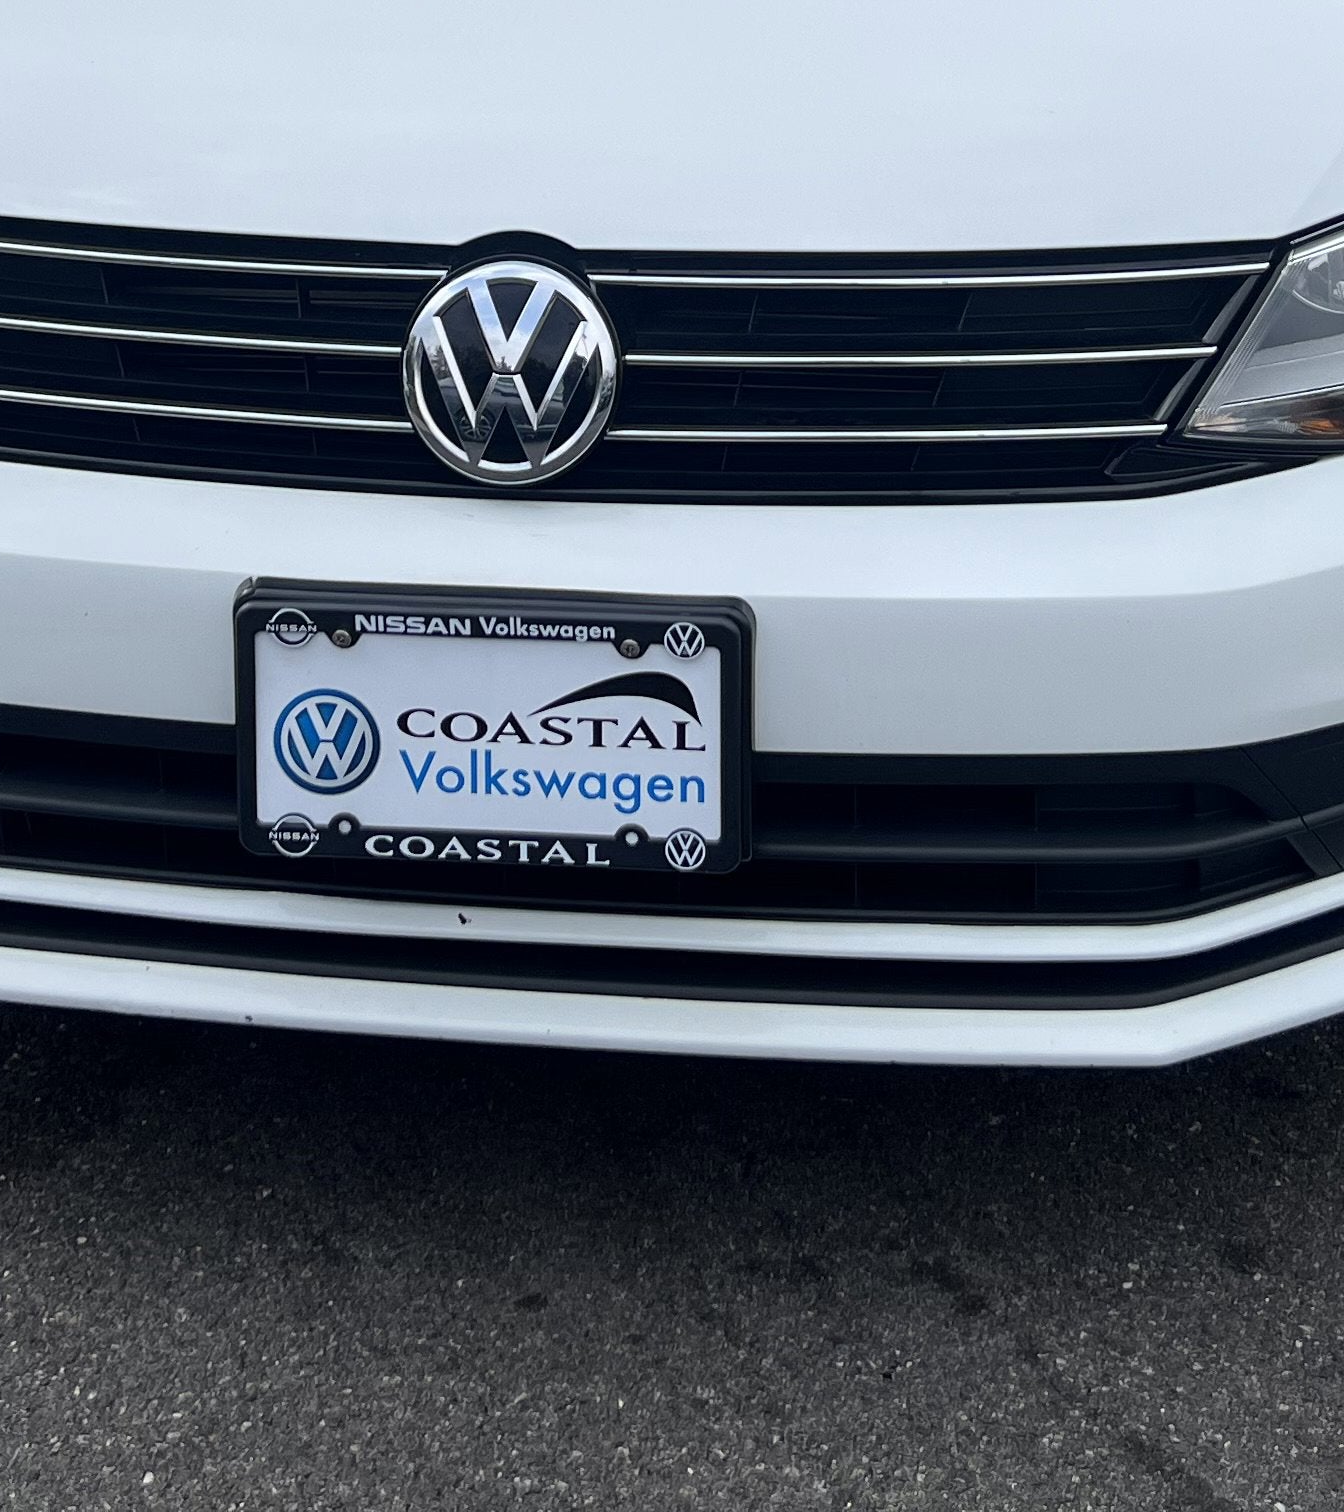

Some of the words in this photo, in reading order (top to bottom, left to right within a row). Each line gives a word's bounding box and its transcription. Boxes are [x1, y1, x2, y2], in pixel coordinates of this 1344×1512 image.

[265, 622, 318, 633] NISSAN
[354, 614, 472, 637] NISSAN
[478, 616, 616, 643] Volkswagen
[396, 706, 707, 752] COASTAL
[399, 748, 706, 814] Volkswagen
[268, 831, 320, 843] NISSAN
[364, 834, 611, 867] COASTAL
